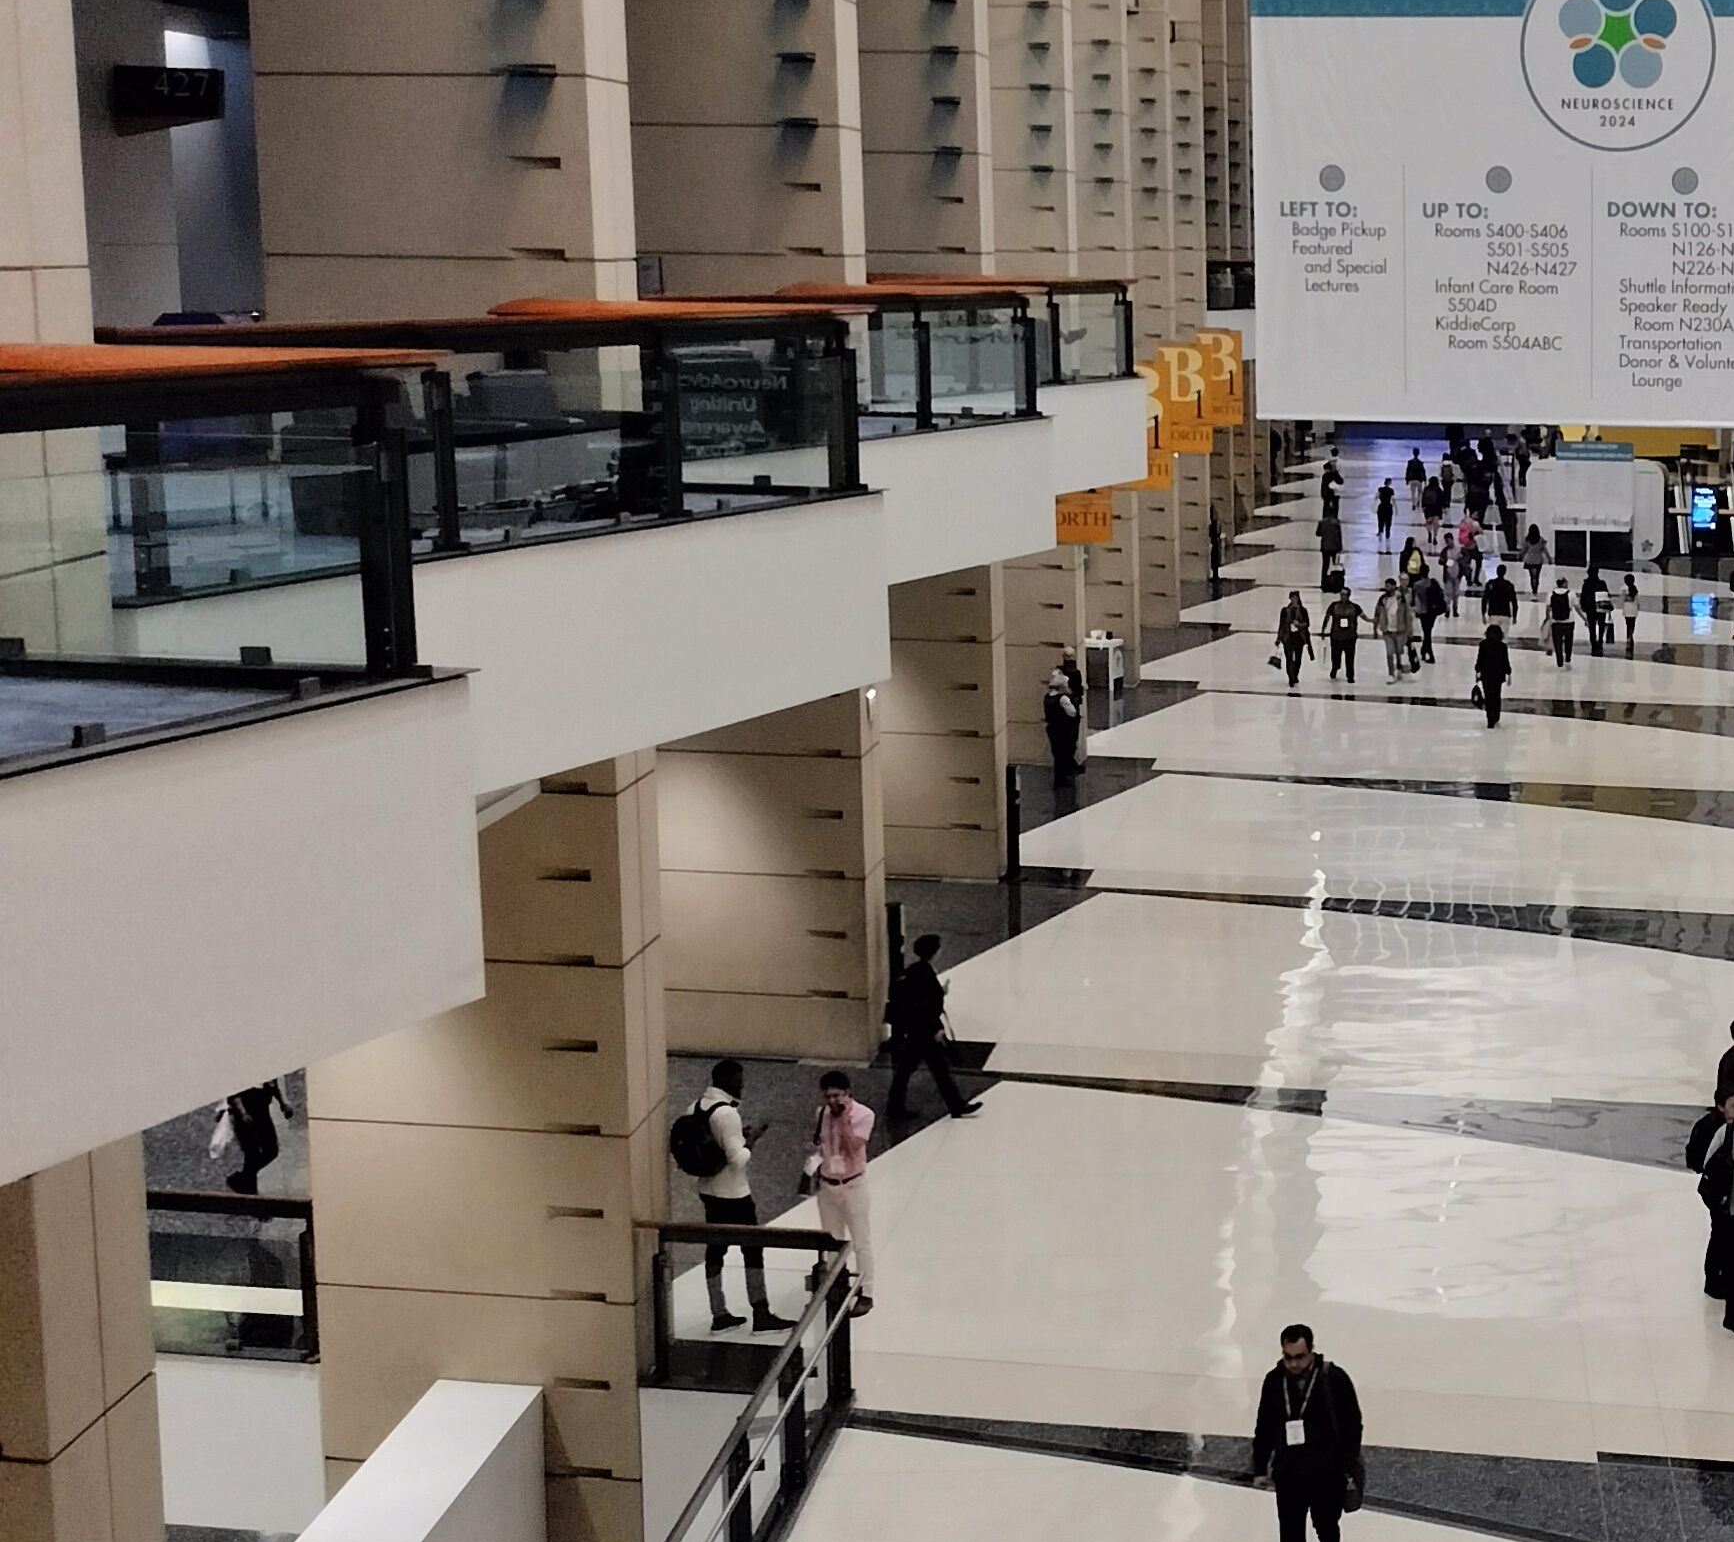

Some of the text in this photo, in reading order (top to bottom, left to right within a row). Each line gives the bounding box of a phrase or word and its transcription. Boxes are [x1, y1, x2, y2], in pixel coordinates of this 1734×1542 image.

[154, 71, 210, 97] 427
[1561, 98, 1674, 110] NEUROSCIENCE
[1599, 115, 1636, 127] 2024
[1279, 201, 1358, 218] LEFT TO:
[1422, 202, 1489, 219] UP TO:
[1607, 201, 1717, 219] DOWN TO:
[1292, 220, 1387, 242] Badge Pickup
[1435, 222, 1568, 239] Rooms S400-S406
[1619, 222, 1667, 238] Rooms
[1292, 239, 1353, 255] Featured
[1487, 242, 1570, 258] S501-S505
[1304, 257, 1387, 278] and Special
[1487, 260, 1578, 277] N426-N427
[1305, 277, 1360, 293] Lectures
[1435, 277, 1559, 295] Infant Care Room
[1619, 277, 1666, 294] Shuttle
[1448, 297, 1497, 313] S504D
[1619, 296, 1727, 318] Speaker Ready
[1435, 314, 1516, 336] KiddieCorp
[1634, 316, 1734, 333] Room N230A
[1448, 334, 1563, 351] Room S504ABC
[1619, 334, 1722, 354] Transportation
[1197, 332, 1237, 381] B
[1619, 353, 1663, 369] Donor
[1668, 354, 1680, 369] &
[1158, 347, 1206, 402] B
[1632, 372, 1683, 392] Lounge
